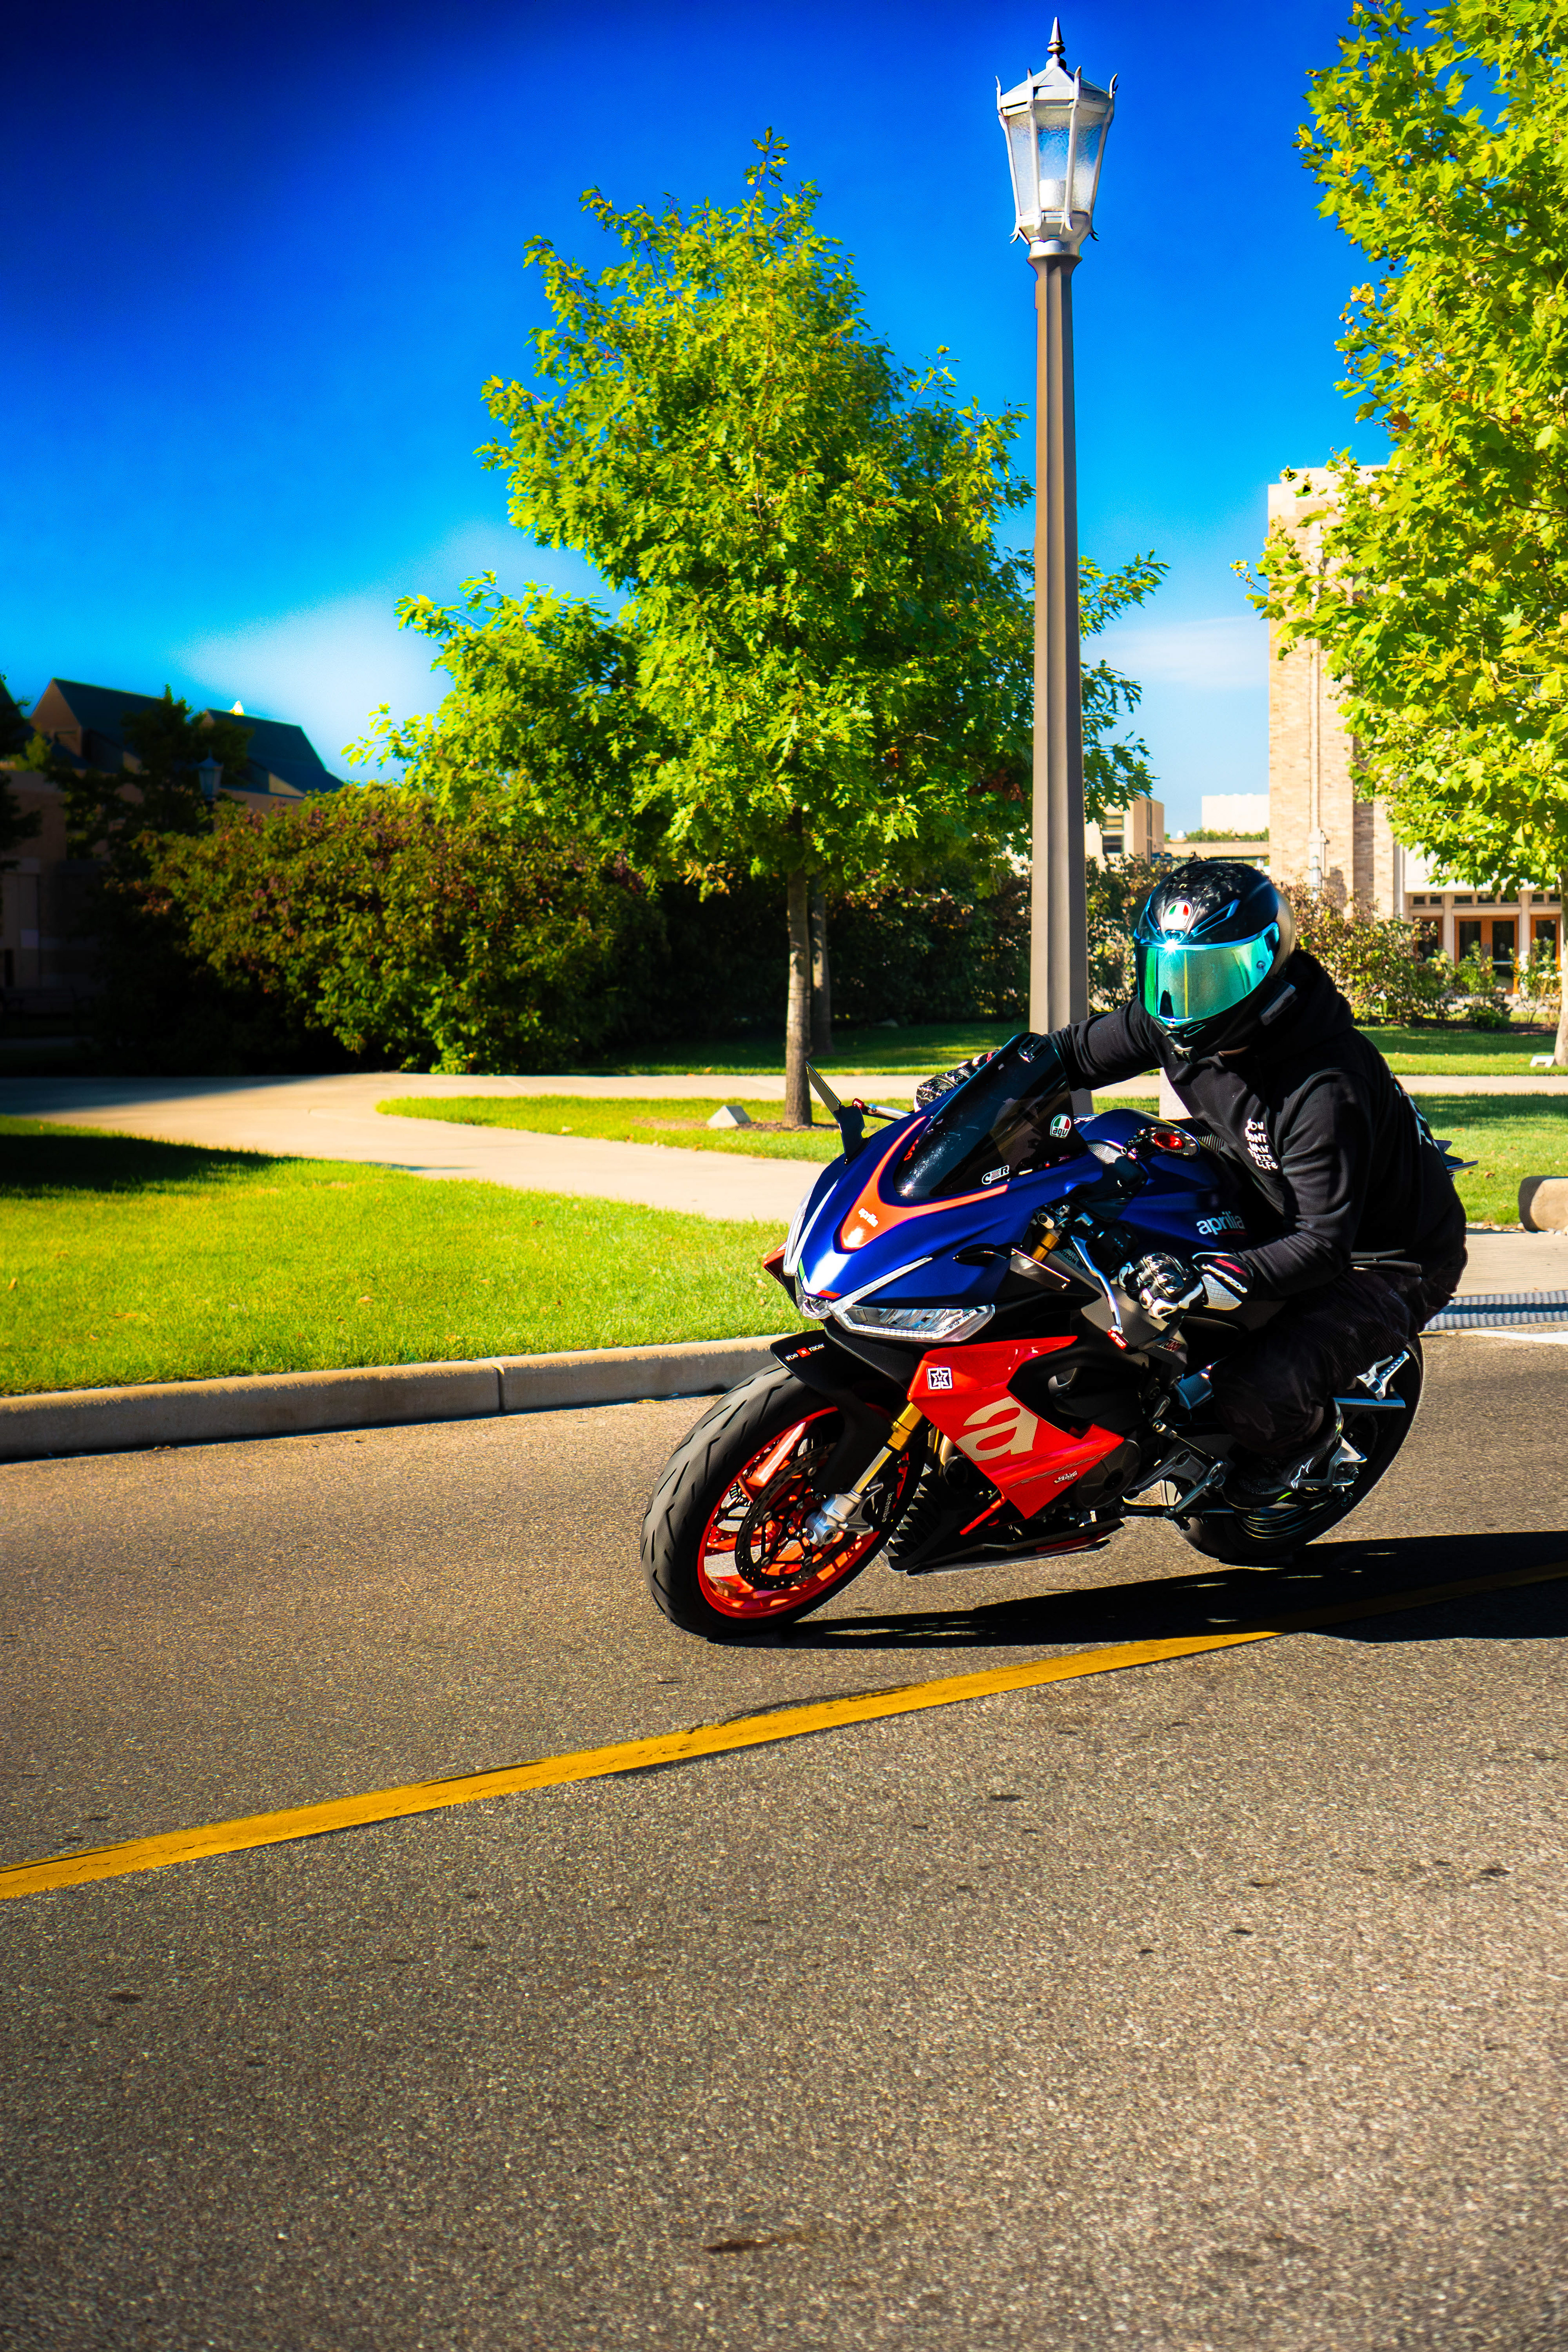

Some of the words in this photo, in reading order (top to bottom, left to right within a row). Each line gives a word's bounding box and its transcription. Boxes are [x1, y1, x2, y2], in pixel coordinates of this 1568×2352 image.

[1053, 1127, 1068, 1137] agv
[982, 1165, 1009, 1184] C2R
[1196, 1211, 1245, 1235] aprilia
[1059, 1249, 1077, 1264] RIZON
[785, 1353, 799, 1361] #be
[808, 1343, 825, 1352] racer
[882, 1492, 895, 1523] brembo
